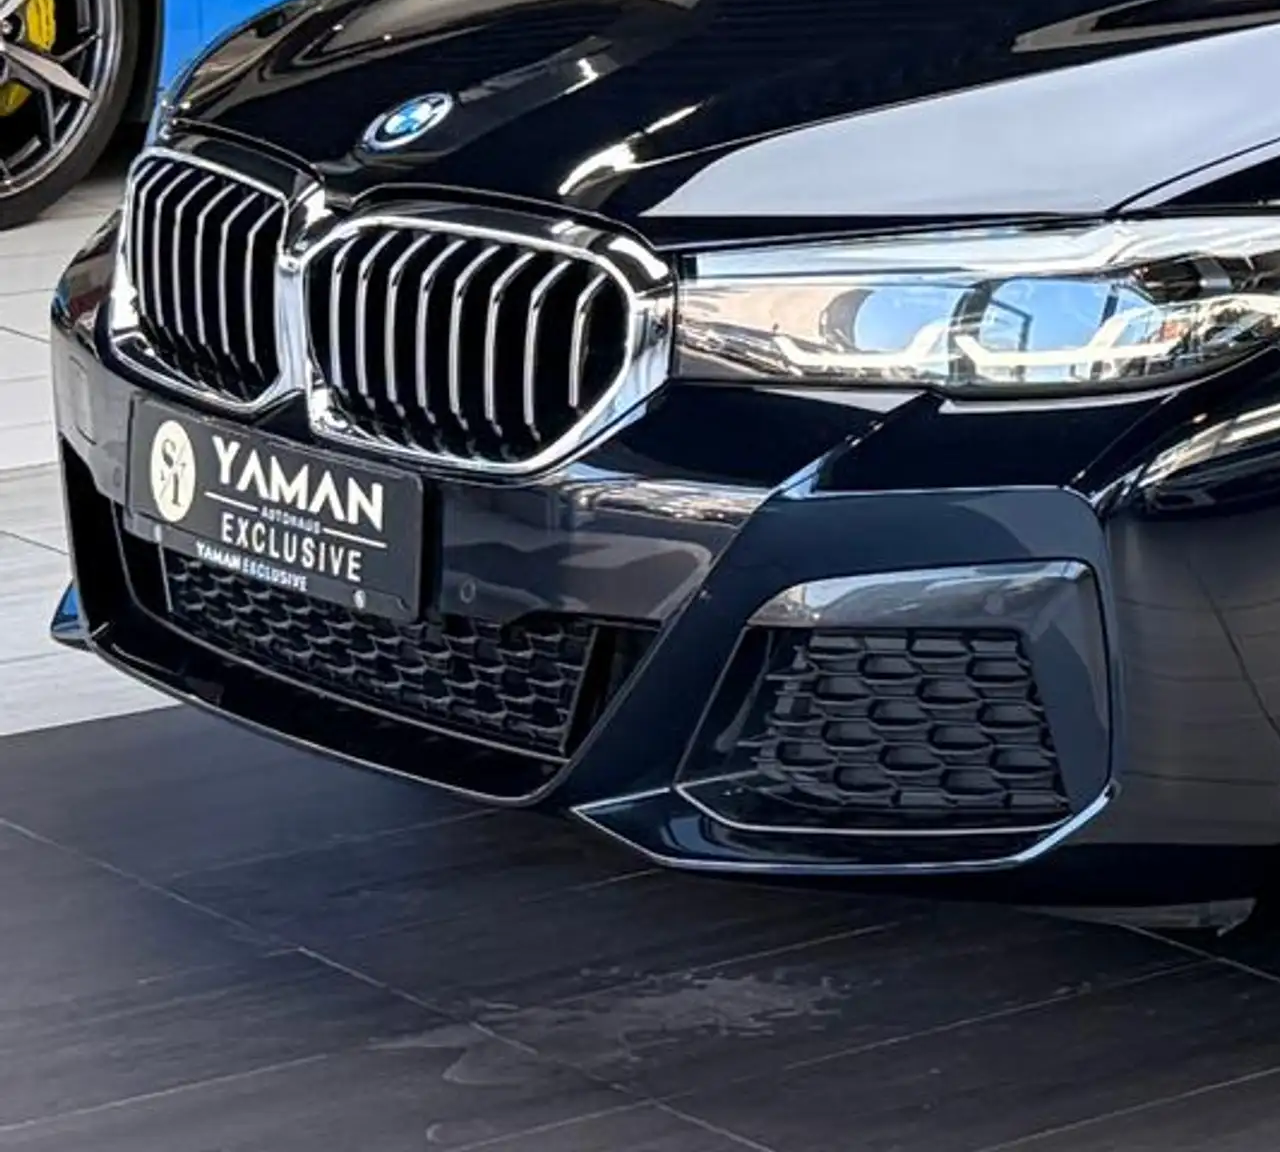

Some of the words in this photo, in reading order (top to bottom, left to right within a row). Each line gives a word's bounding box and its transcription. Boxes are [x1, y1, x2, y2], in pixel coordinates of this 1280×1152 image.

[212, 435, 383, 532] YAMAN
[221, 512, 362, 582] EXCLUSIVE
[260, 506, 321, 535] AUTOHAUS
[196, 540, 242, 571] YAMAN
[242, 556, 308, 592] EXCLUSIVE
